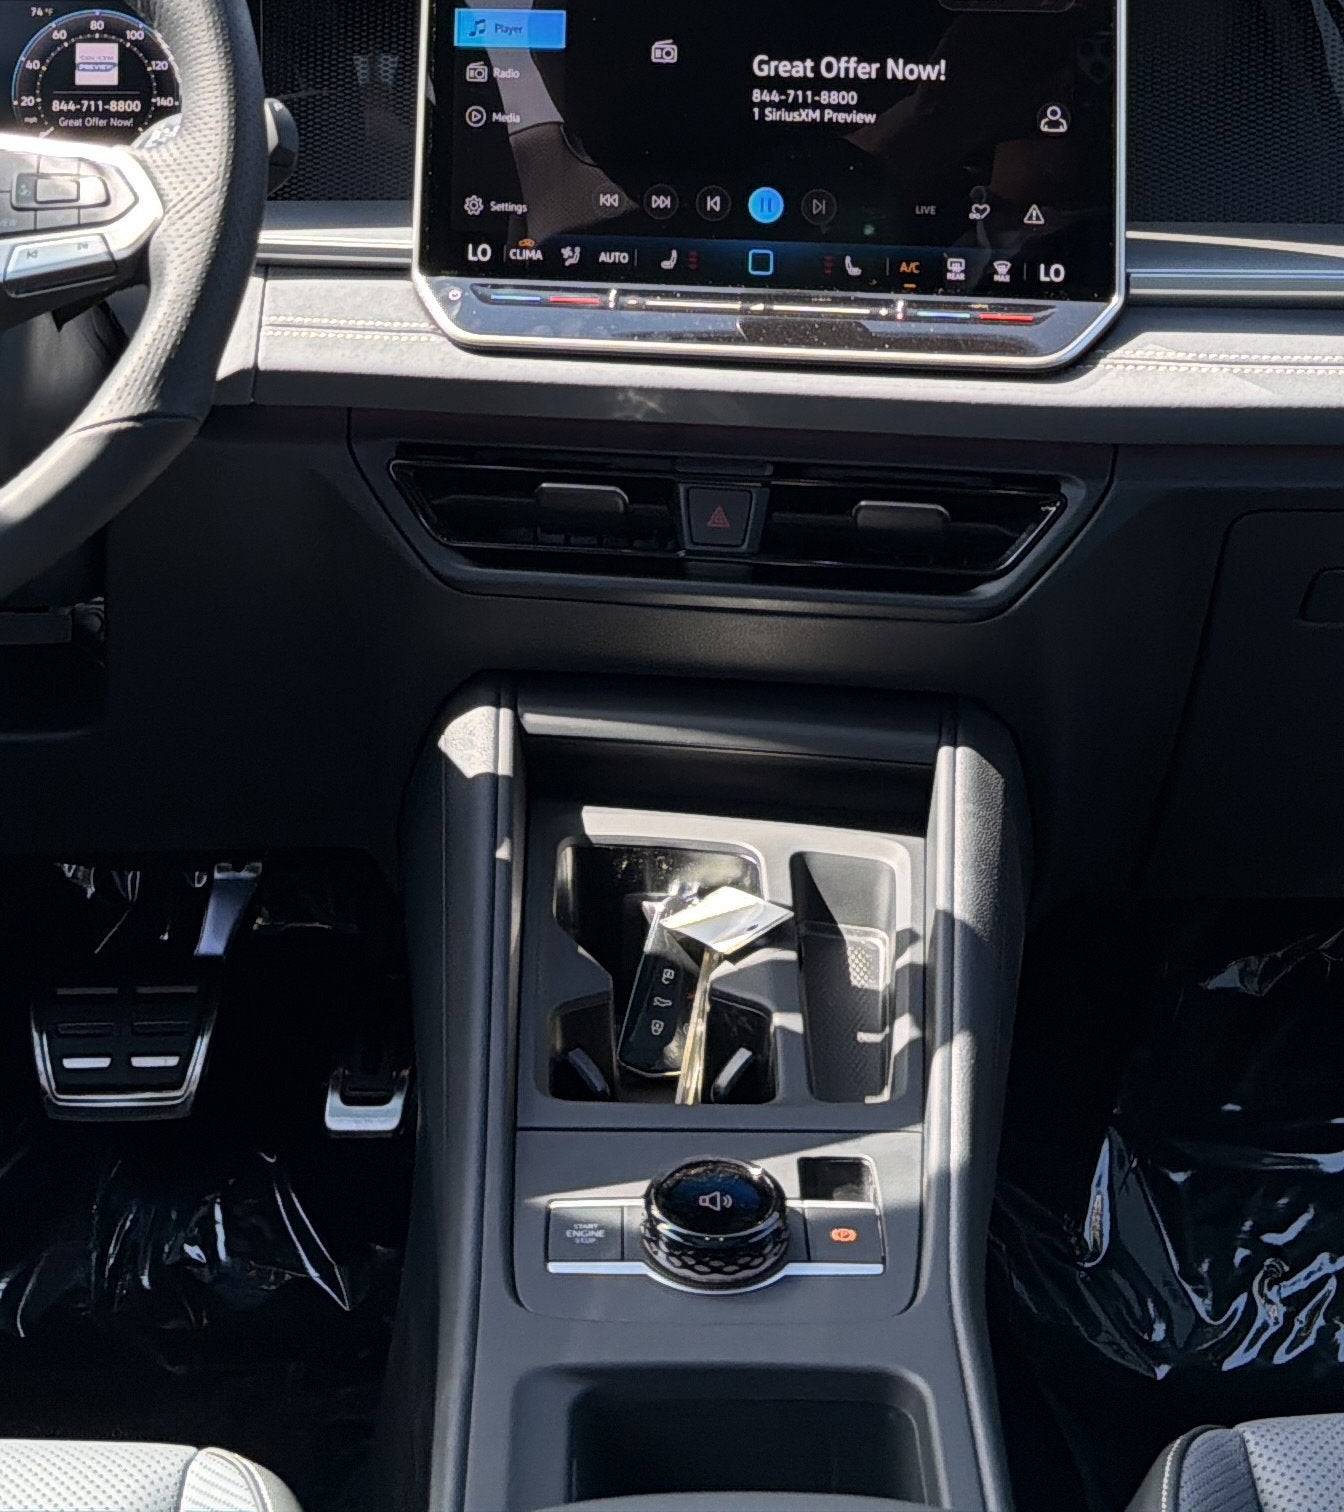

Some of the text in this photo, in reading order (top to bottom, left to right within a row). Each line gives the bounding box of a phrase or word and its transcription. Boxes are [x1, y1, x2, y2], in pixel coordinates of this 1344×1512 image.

[31, 8, 43, 17] 74
[90, 21, 104, 29] 80
[495, 23, 524, 36] Player
[53, 31, 67, 39] 60
[126, 31, 144, 39] 100
[26, 60, 40, 70] 40
[151, 61, 168, 70] 120
[753, 56, 948, 81] Great Offer Now!
[493, 68, 520, 79] Radio
[21, 96, 35, 106] 20
[156, 97, 173, 106] 140
[752, 90, 857, 105] 844-711-8800
[52, 100, 141, 112] 844-711-8800
[492, 111, 521, 124] Media
[753, 108, 876, 125] 1 SiriusXM Preview
[59, 118, 133, 127] Great Offer Now!
[490, 201, 528, 215] Settings
[915, 205, 936, 216] LIVE
[467, 243, 492, 262] LO
[509, 248, 543, 262] CLIMA
[598, 252, 629, 265] AUTO
[900, 261, 920, 275] A/C
[1040, 264, 1065, 282] LO
[947, 273, 965, 281] REAR
[566, 1229, 606, 1238] ENGINE
